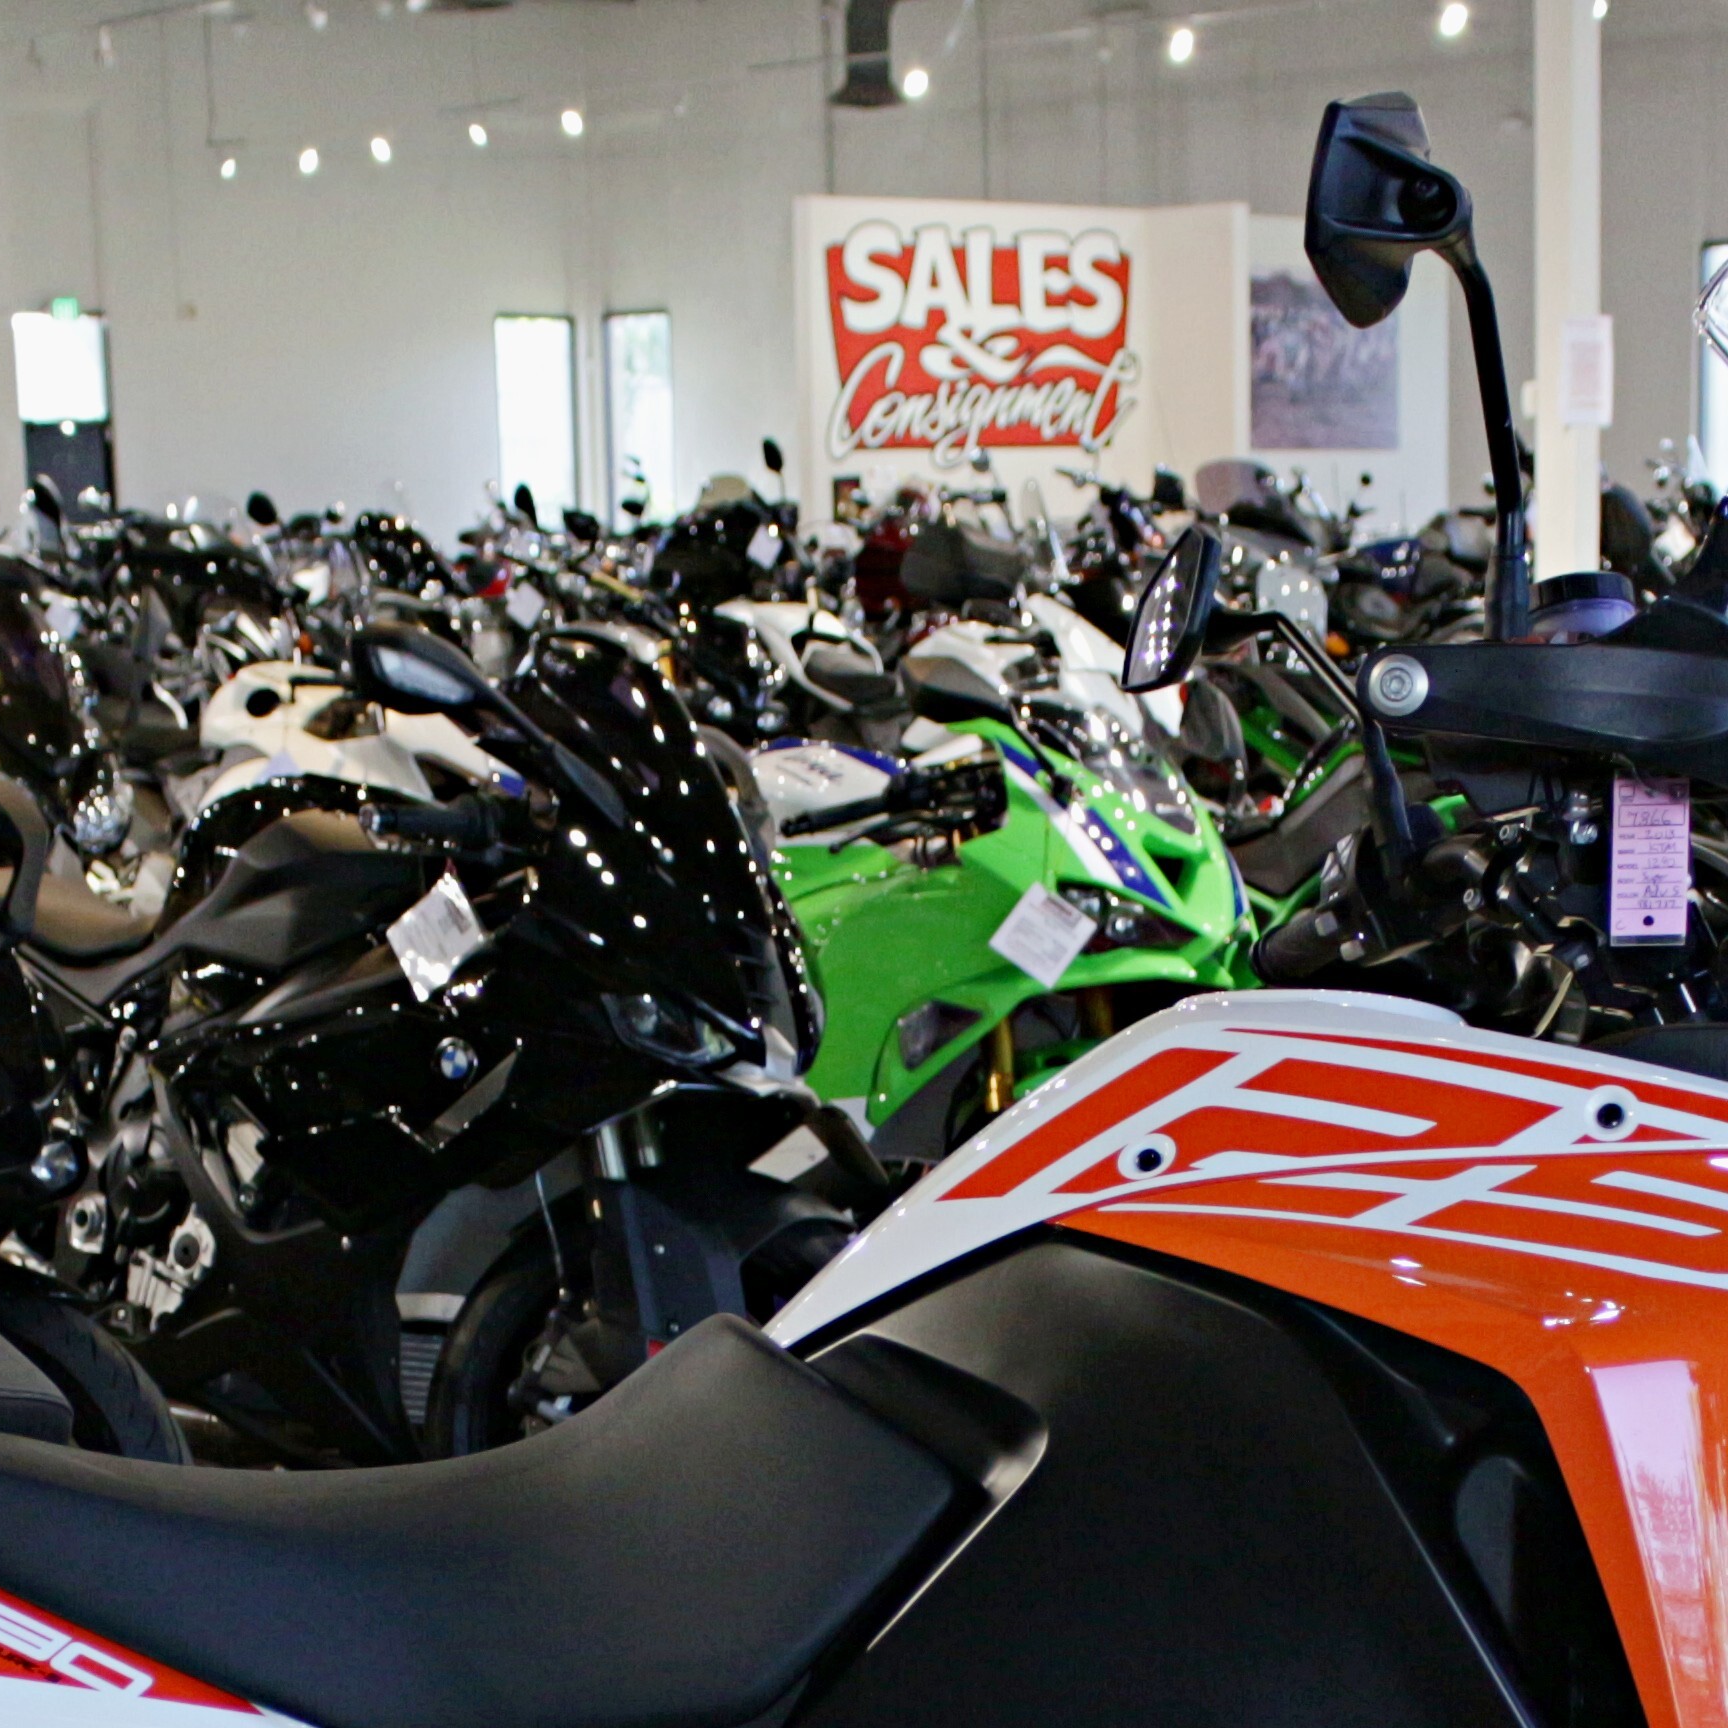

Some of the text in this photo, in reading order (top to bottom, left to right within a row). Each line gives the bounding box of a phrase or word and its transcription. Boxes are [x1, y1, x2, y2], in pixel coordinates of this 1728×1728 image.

[839, 218, 1124, 340] SALES
[829, 341, 1140, 468] Consignment
[918, 322, 1030, 383] &
